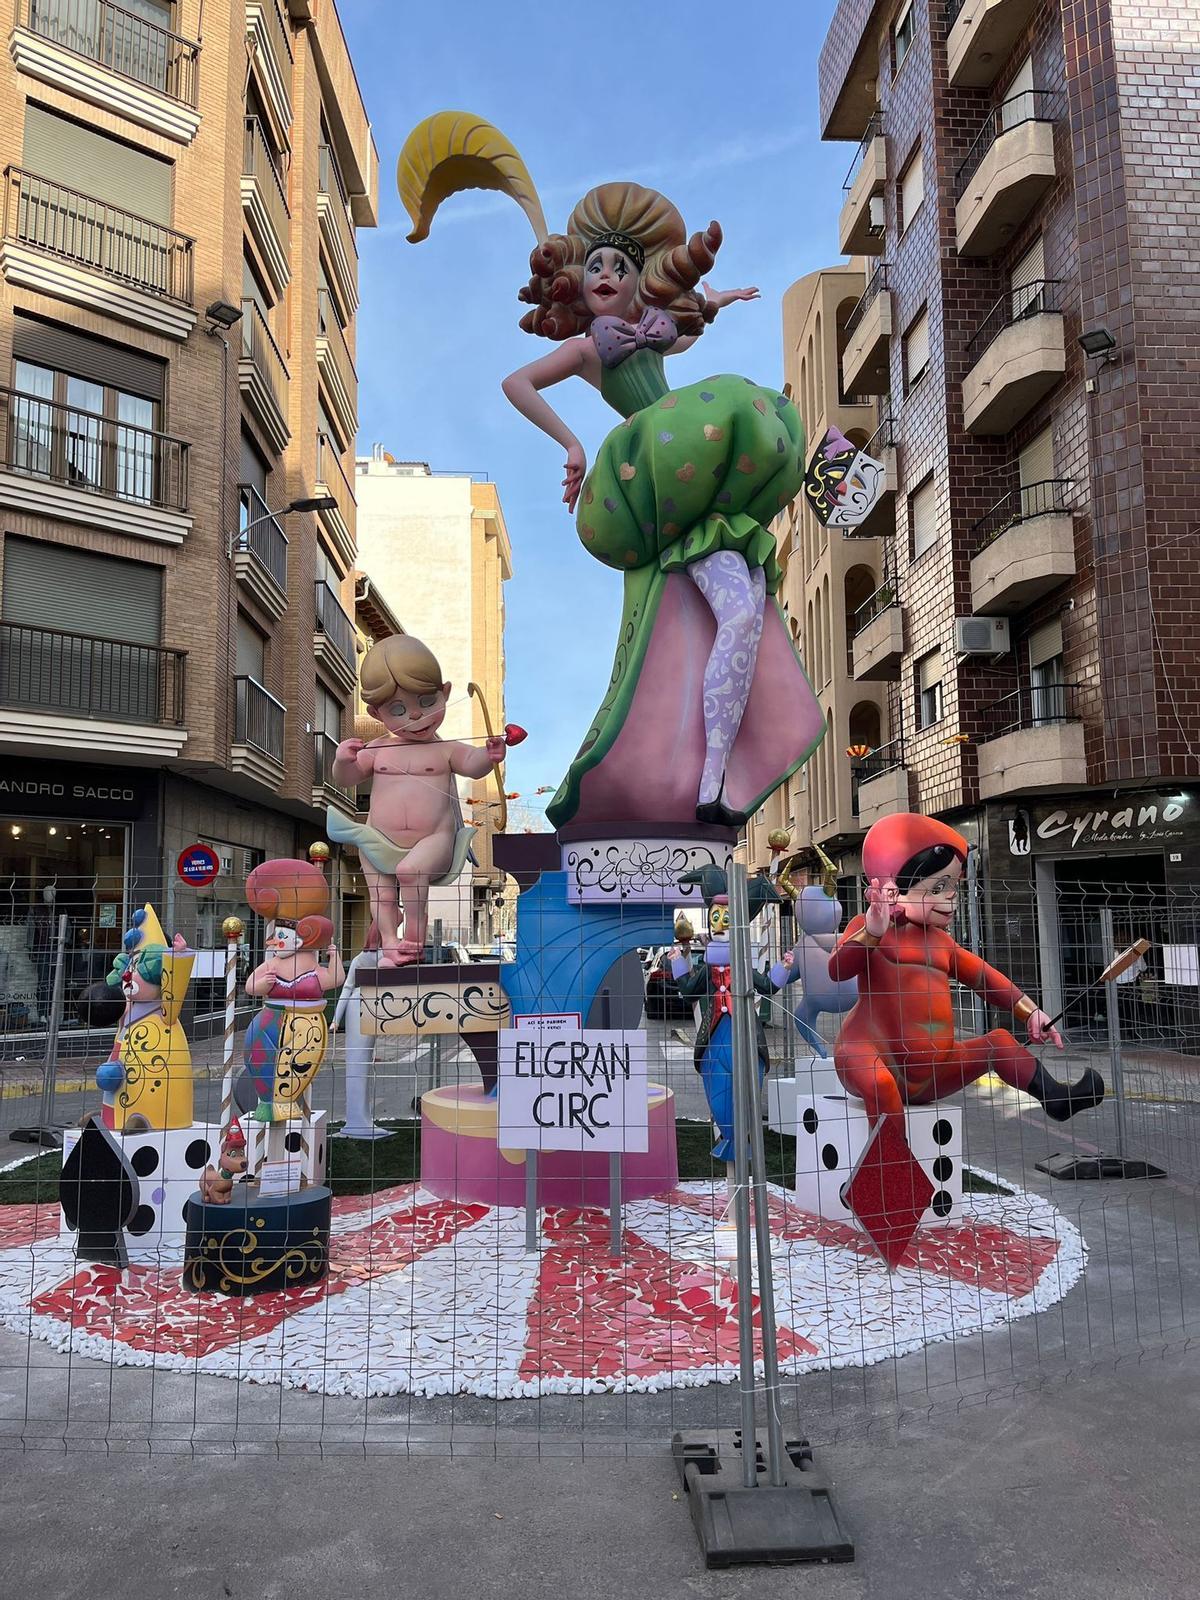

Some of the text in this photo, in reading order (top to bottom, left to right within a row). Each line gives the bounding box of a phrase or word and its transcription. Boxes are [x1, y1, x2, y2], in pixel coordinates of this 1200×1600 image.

[73, 785, 134, 801] SACCO
[1036, 803, 1184, 848] Cyrano
[532, 1091, 611, 1139] CIRC
